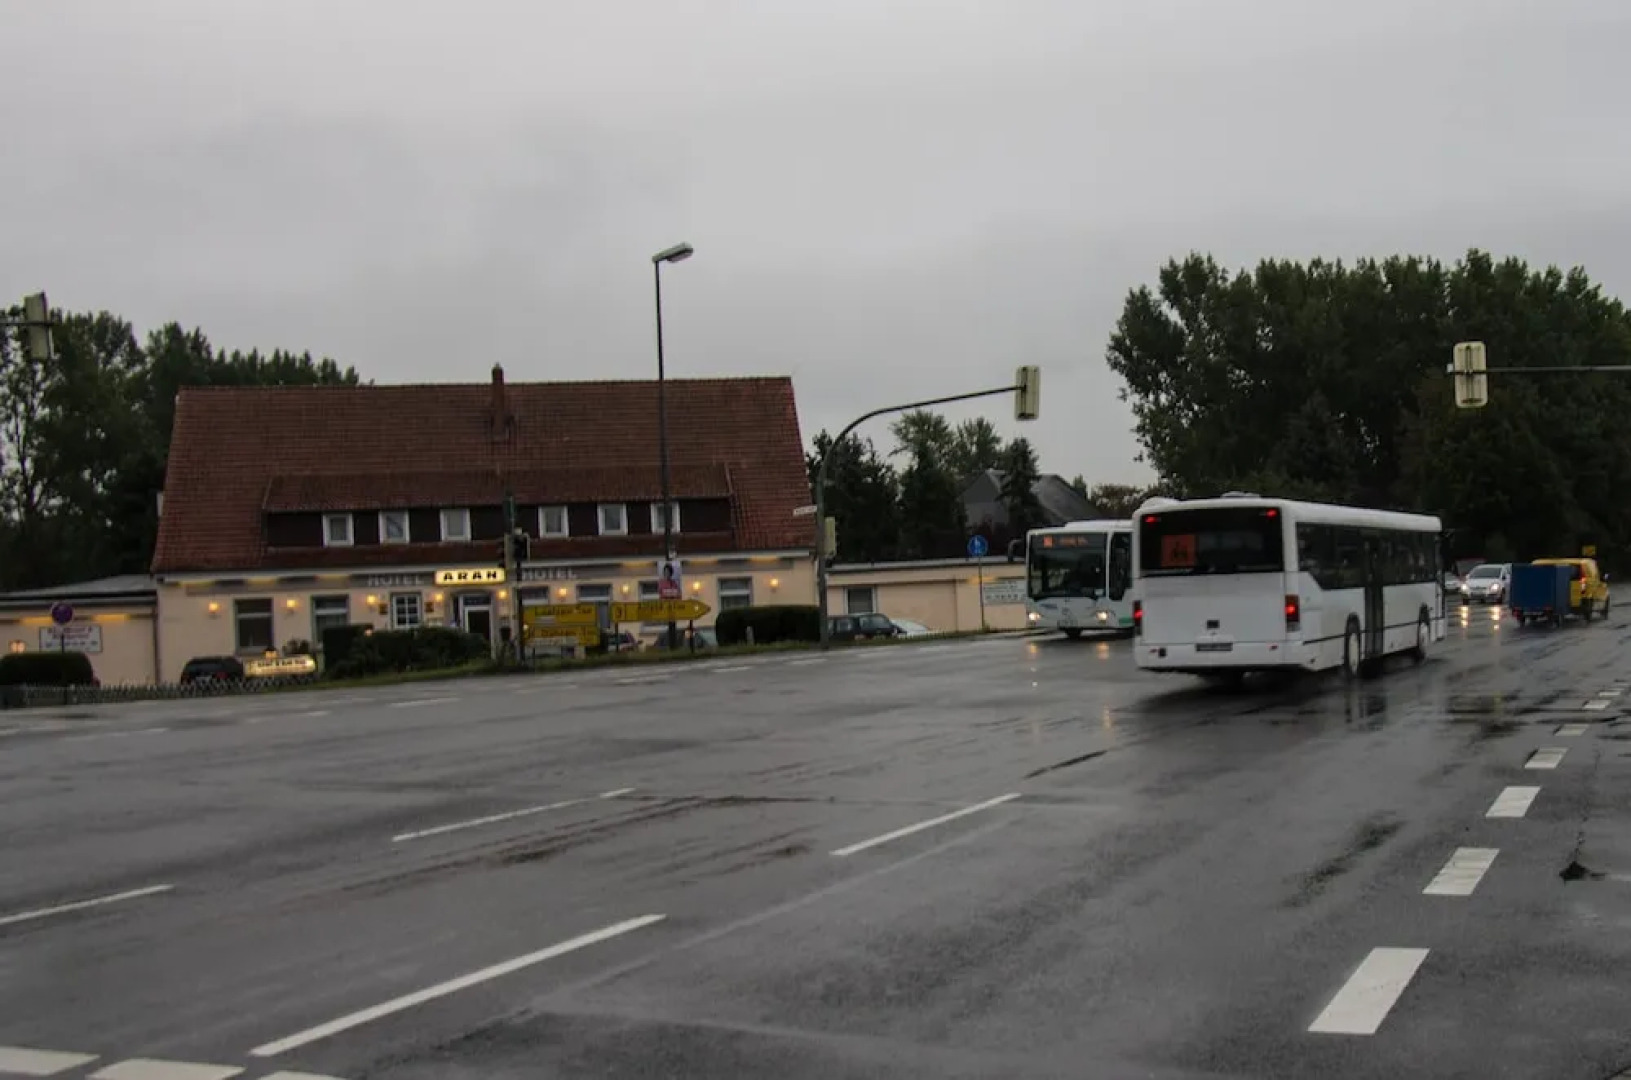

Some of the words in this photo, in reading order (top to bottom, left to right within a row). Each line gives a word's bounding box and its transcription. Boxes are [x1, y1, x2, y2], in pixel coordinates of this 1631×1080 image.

[367, 573, 424, 587] HOTEL
[443, 570, 497, 581] ARAN
[521, 567, 577, 580] HOTEL
